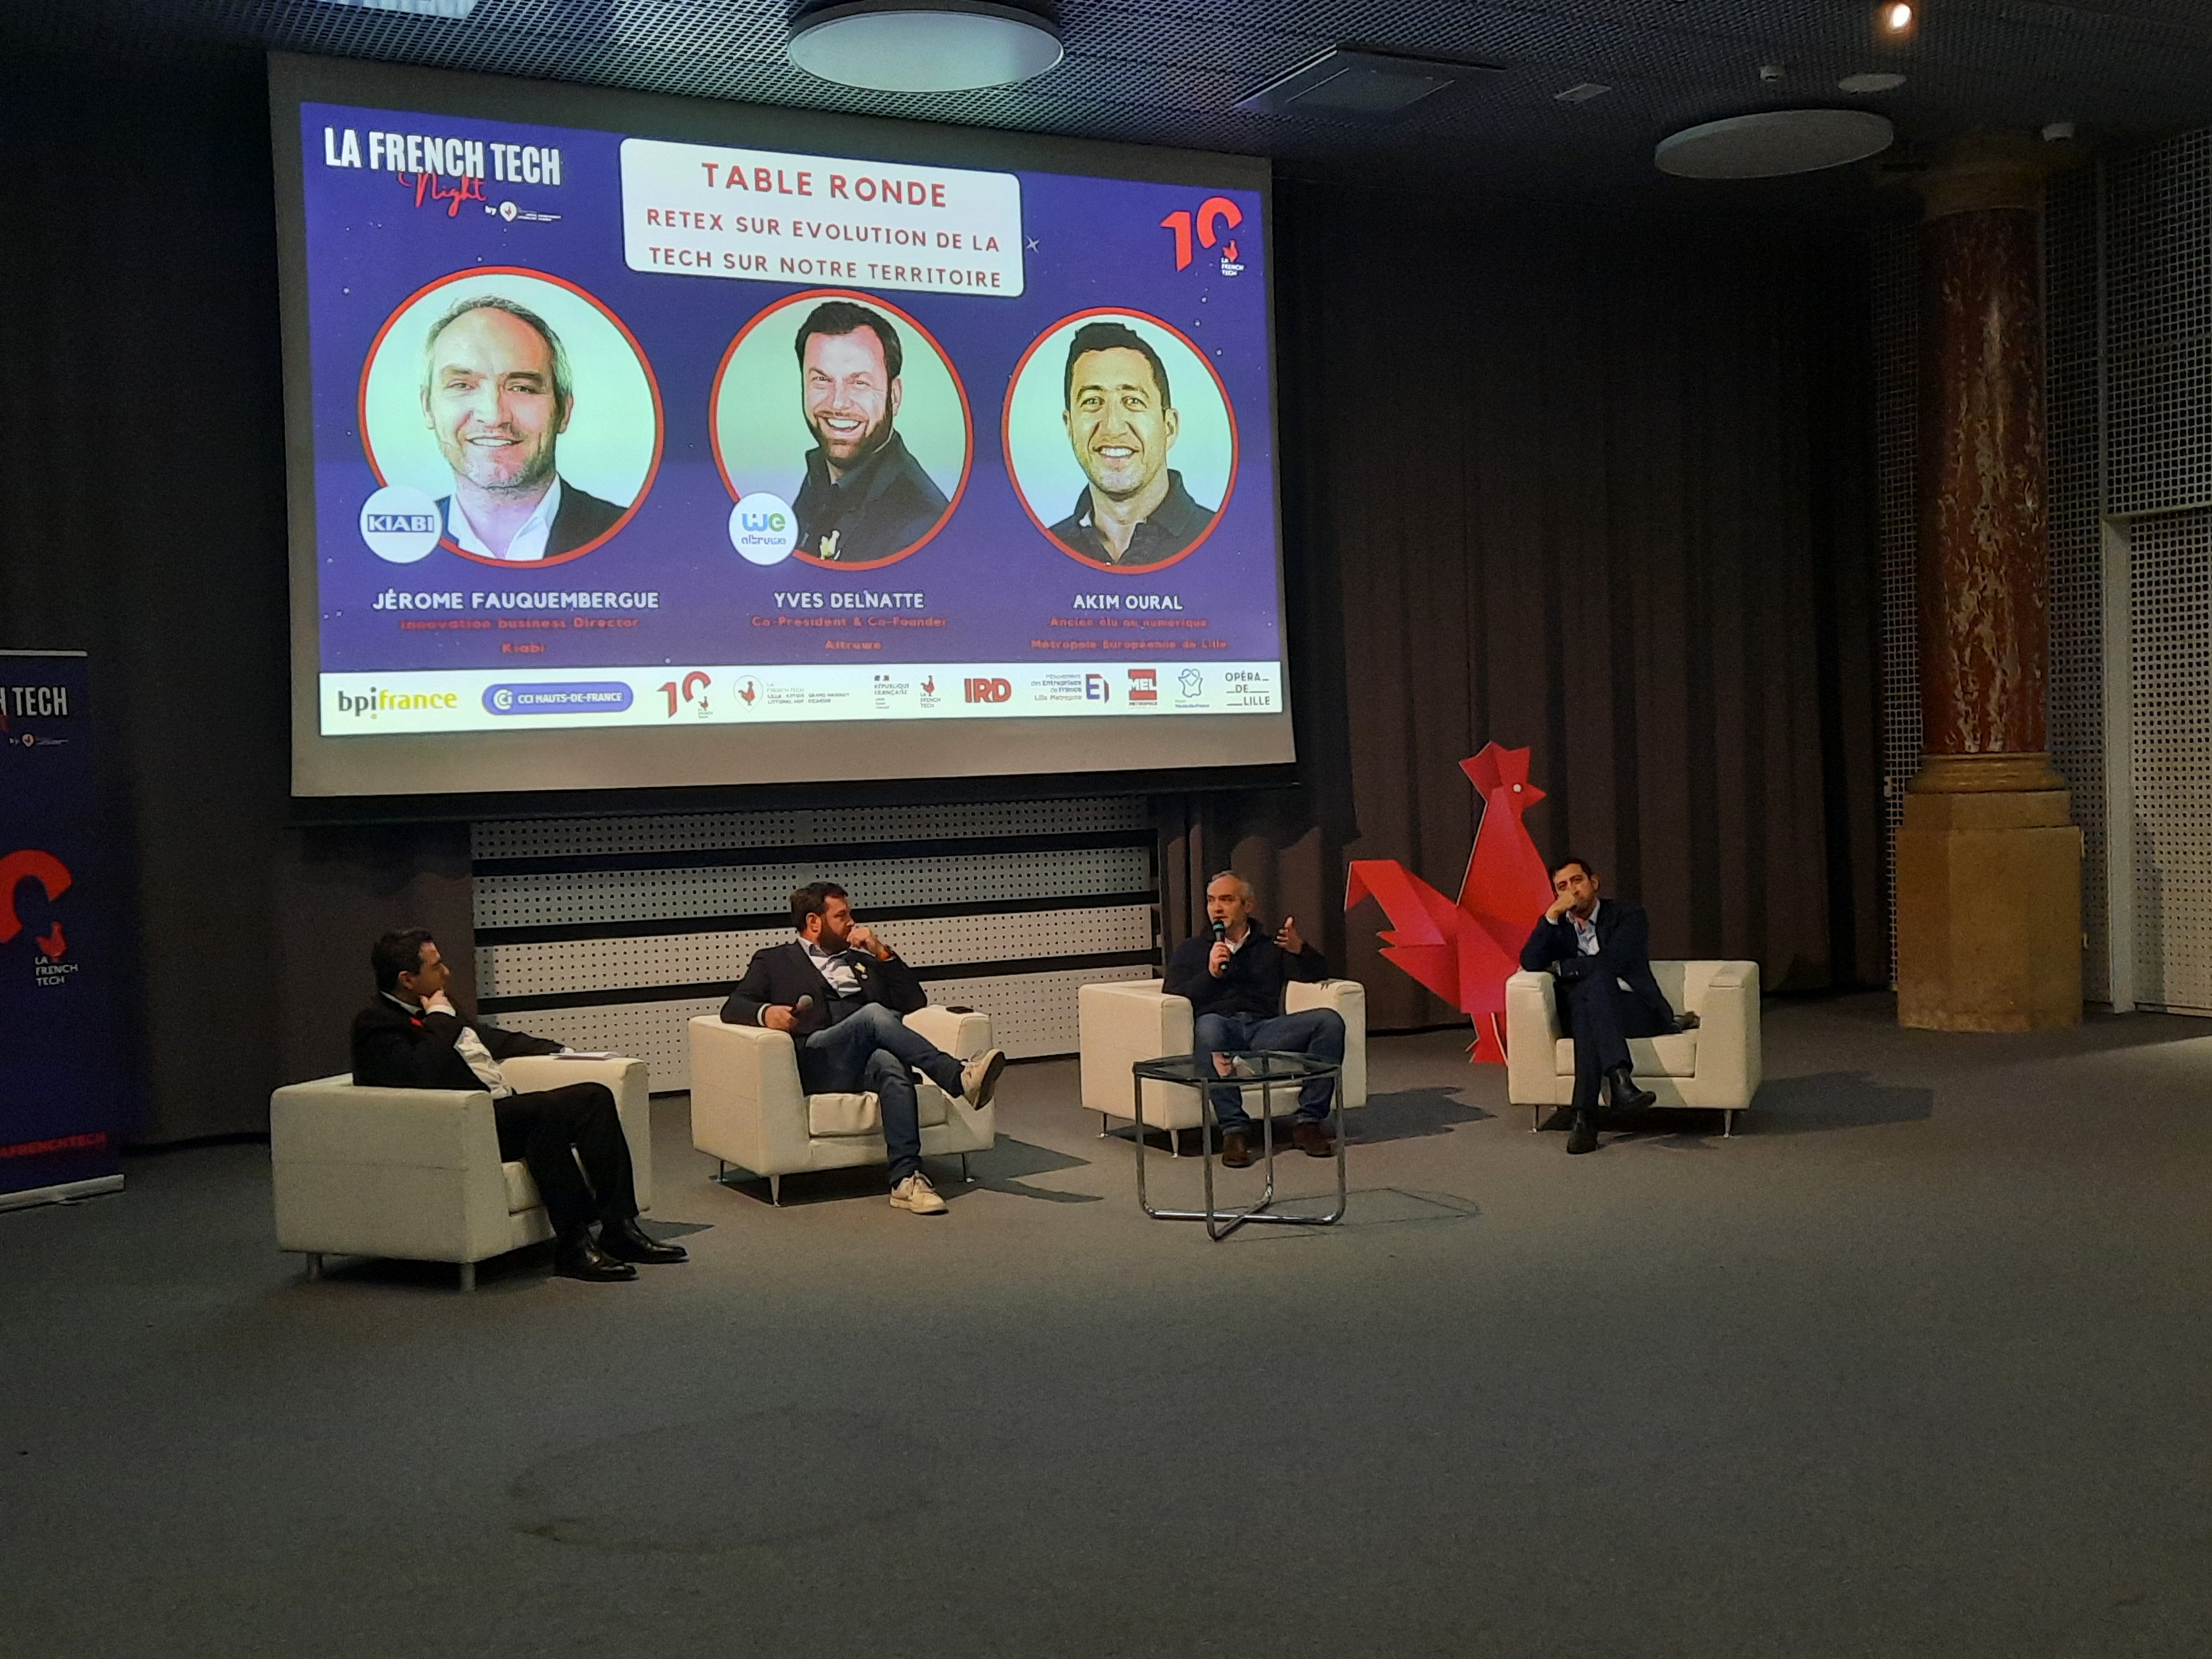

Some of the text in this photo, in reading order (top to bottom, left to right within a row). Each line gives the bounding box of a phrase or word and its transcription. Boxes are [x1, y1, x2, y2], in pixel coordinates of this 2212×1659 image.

[324, 126, 561, 186] LA FRENCH TECH
[397, 169, 488, 217] Night
[702, 163, 946, 208] TABLE RONDE
[647, 208, 999, 252] RETEX SUR EVOLUTION DE LA
[1160, 196, 1243, 272] 10
[649, 247, 1001, 288] TECH SUR NOTRE TERRITOIRE
[368, 515, 434, 531] KIABI
[373, 588, 660, 610] JÉROME FAUQUEMBERGUE
[774, 592, 924, 608] YVES DELNATTE
[1073, 594, 1182, 609] AKIM OURAL
[12, 687, 67, 716] TECH
[518, 694, 534, 705] CCI
[964, 678, 1012, 703] IRD
[1244, 696, 1270, 706] LILLE
[338, 687, 458, 719] bpifrance
[35, 957, 48, 965] LA
[35, 964, 78, 975] FRENCH
[36, 975, 65, 986] TECH
